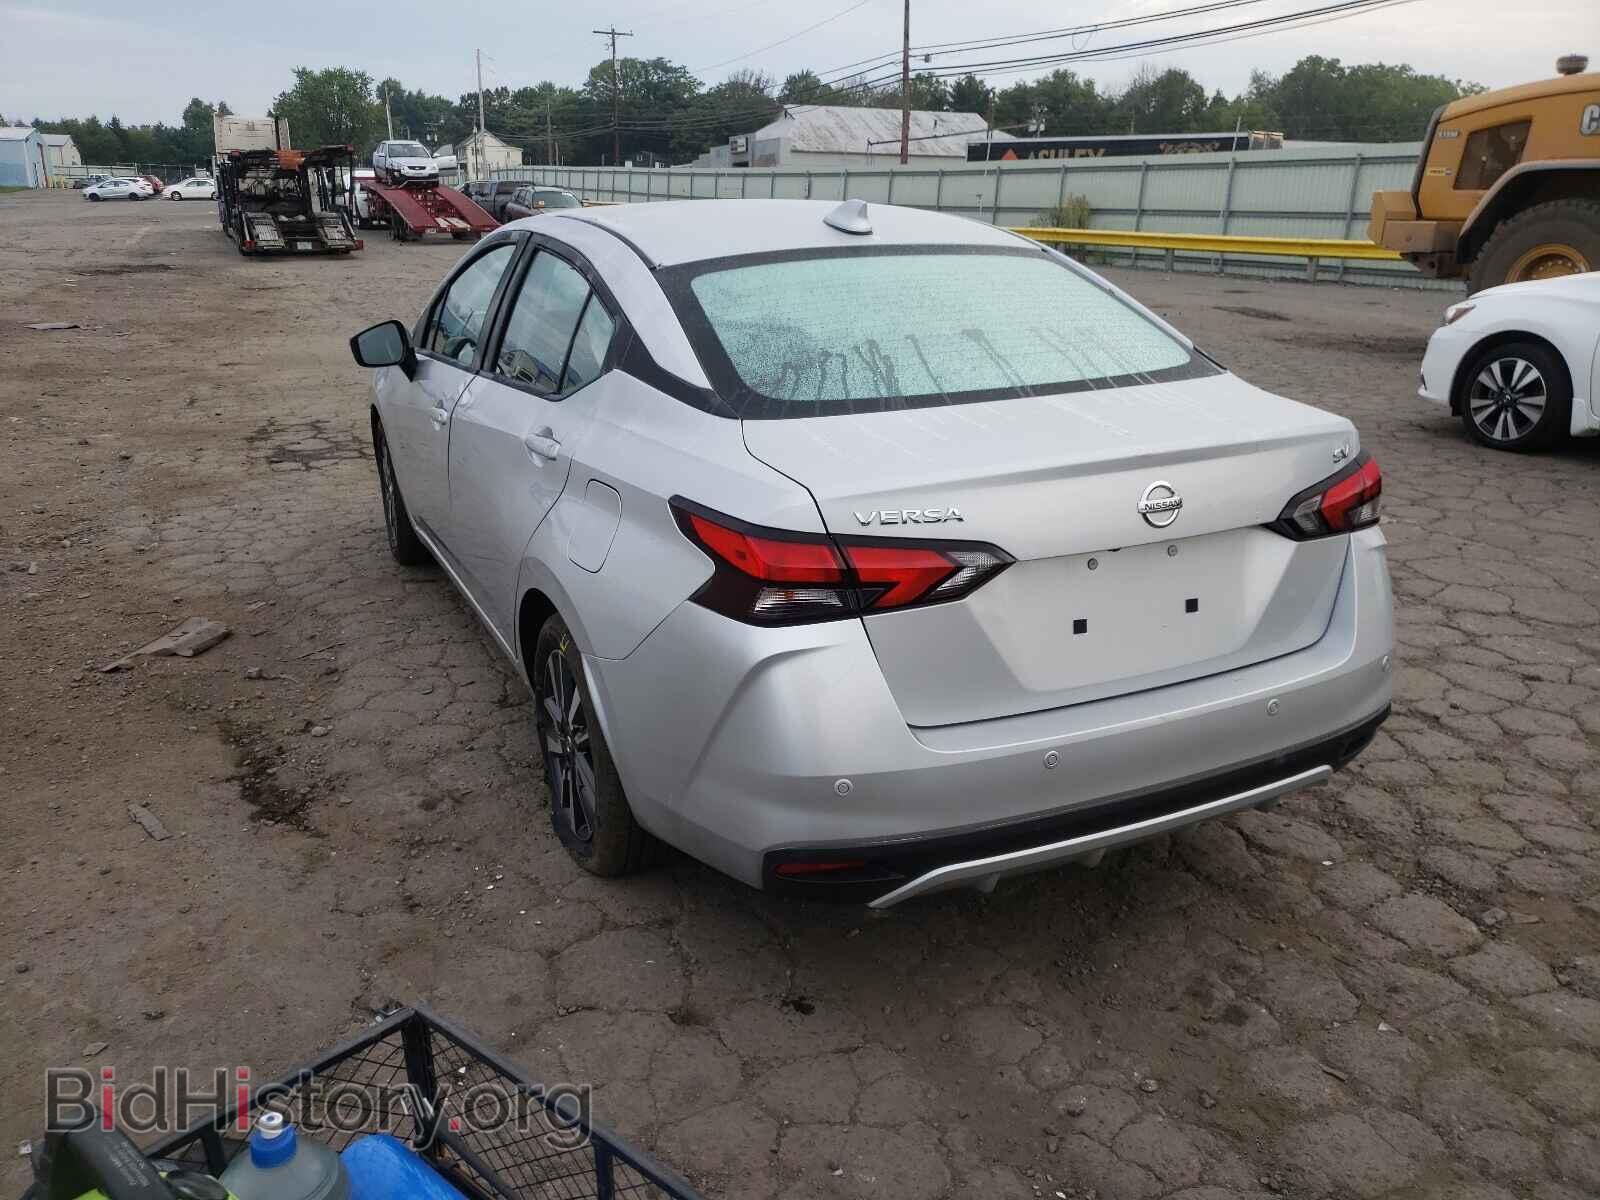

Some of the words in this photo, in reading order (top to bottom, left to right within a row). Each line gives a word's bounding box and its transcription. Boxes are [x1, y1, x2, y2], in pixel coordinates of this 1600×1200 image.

[1333, 444, 1349, 464] SV
[1144, 499, 1181, 511] NISSAN
[853, 507, 965, 526] VERSA
